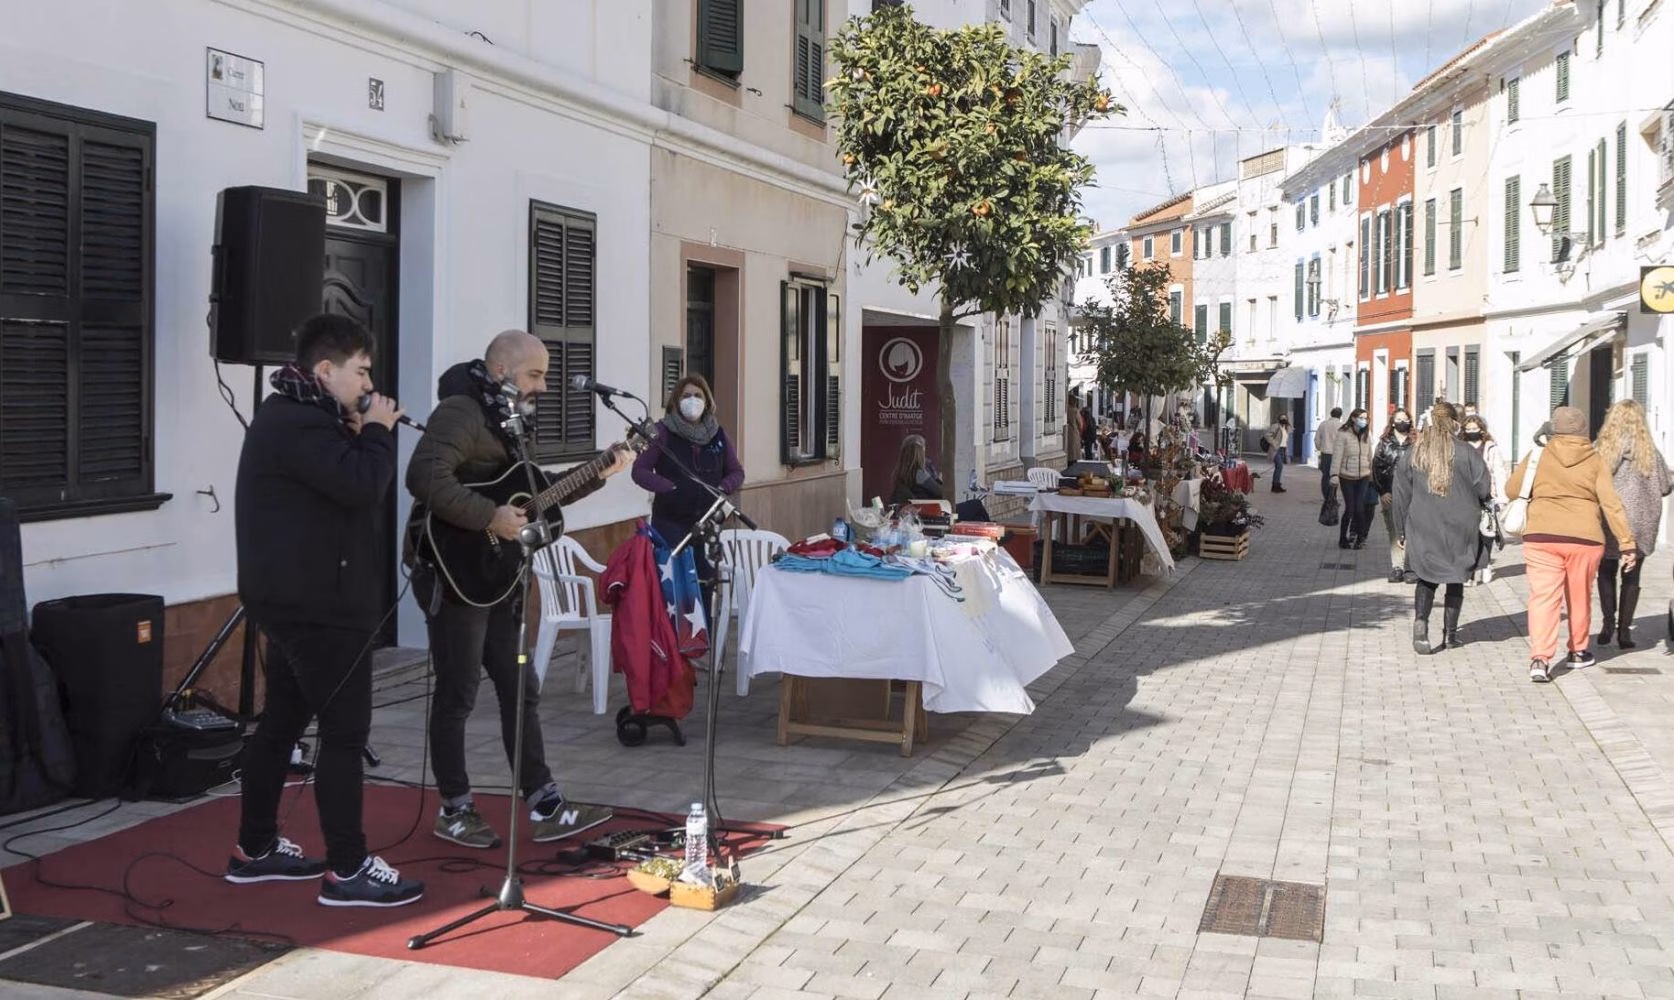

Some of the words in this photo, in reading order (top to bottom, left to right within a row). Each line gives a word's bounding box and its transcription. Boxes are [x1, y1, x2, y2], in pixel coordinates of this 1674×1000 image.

[370, 81, 383, 107] 54
[878, 382, 923, 409] Judit
[559, 810, 579, 825] N
[449, 821, 466, 836] N
